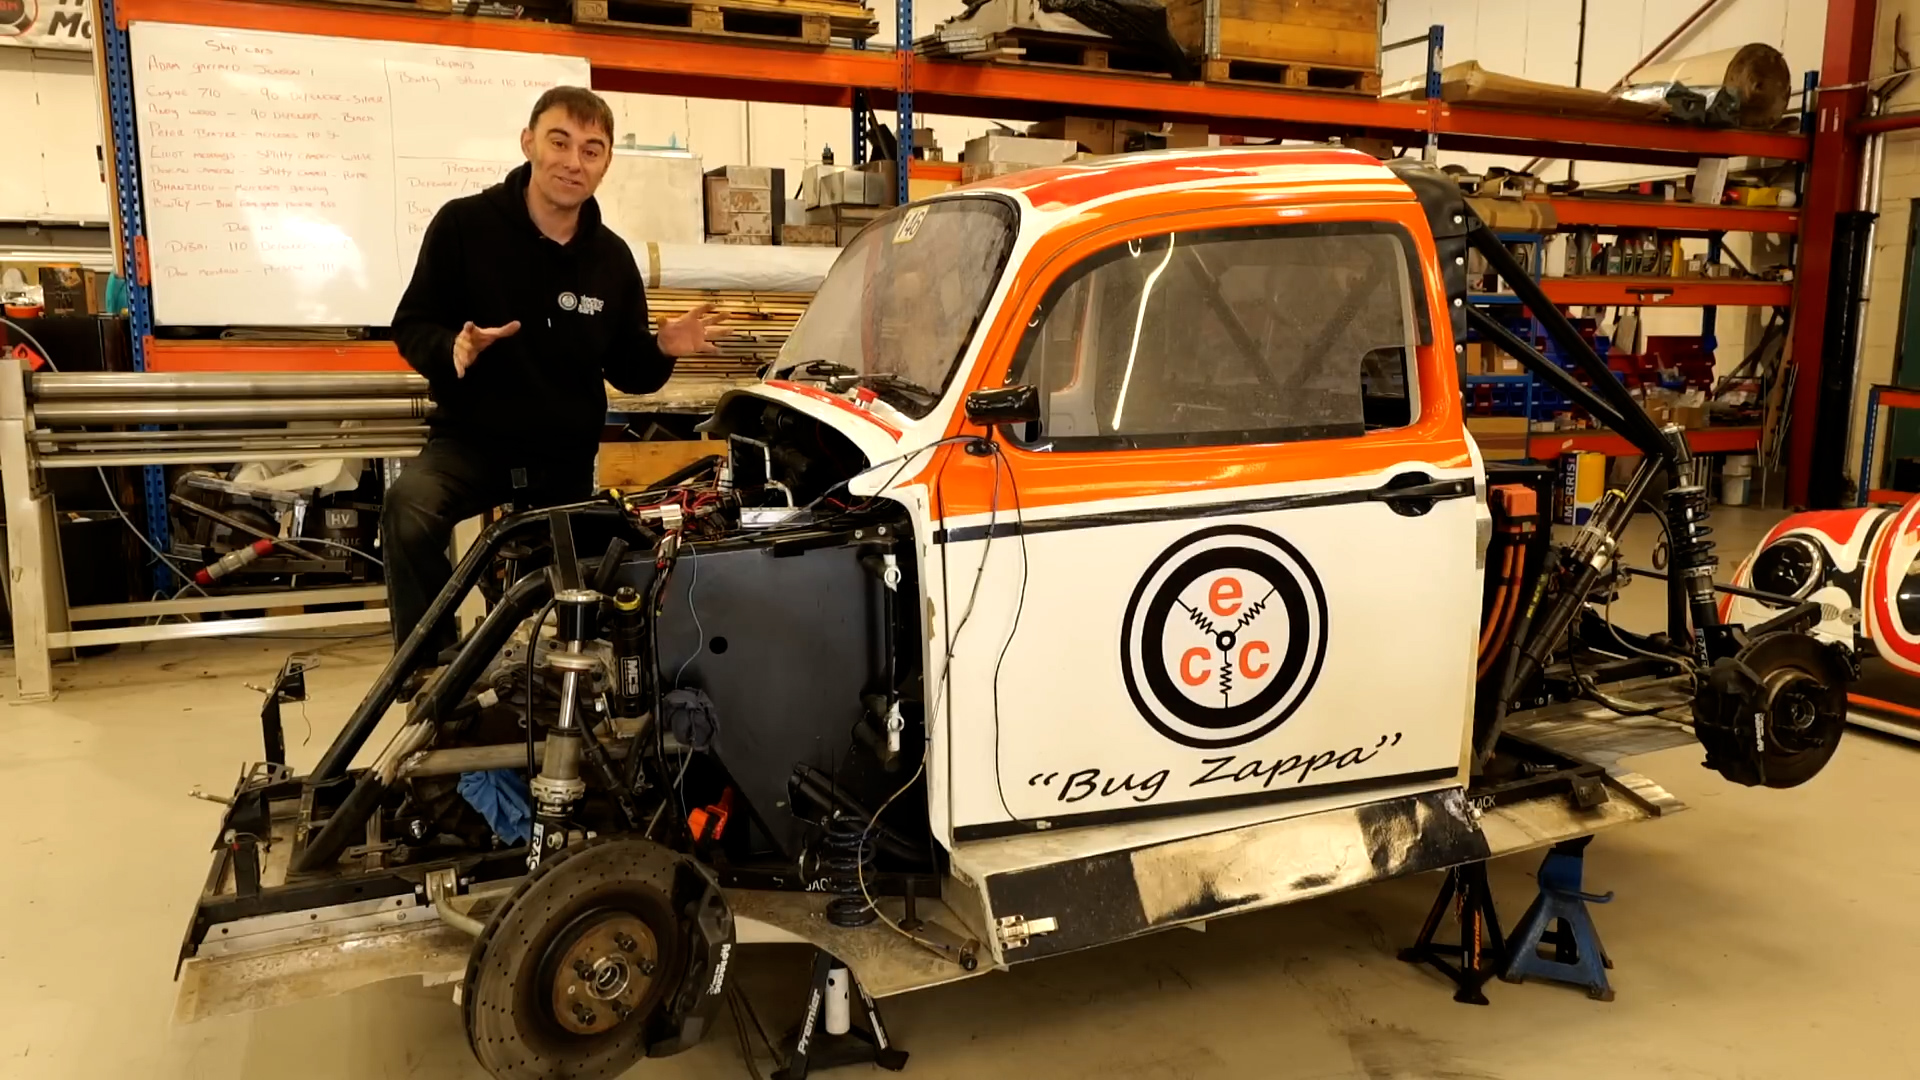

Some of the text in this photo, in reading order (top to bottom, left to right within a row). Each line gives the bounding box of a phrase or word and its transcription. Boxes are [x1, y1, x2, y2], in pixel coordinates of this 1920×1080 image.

[898, 211, 926, 237] 146
[1563, 463, 1576, 517] MORRIS
[331, 513, 350, 526] HV
[627, 659, 640, 695] MCS
[804, 877, 832, 892] JAC
[797, 988, 820, 1056] Premier
